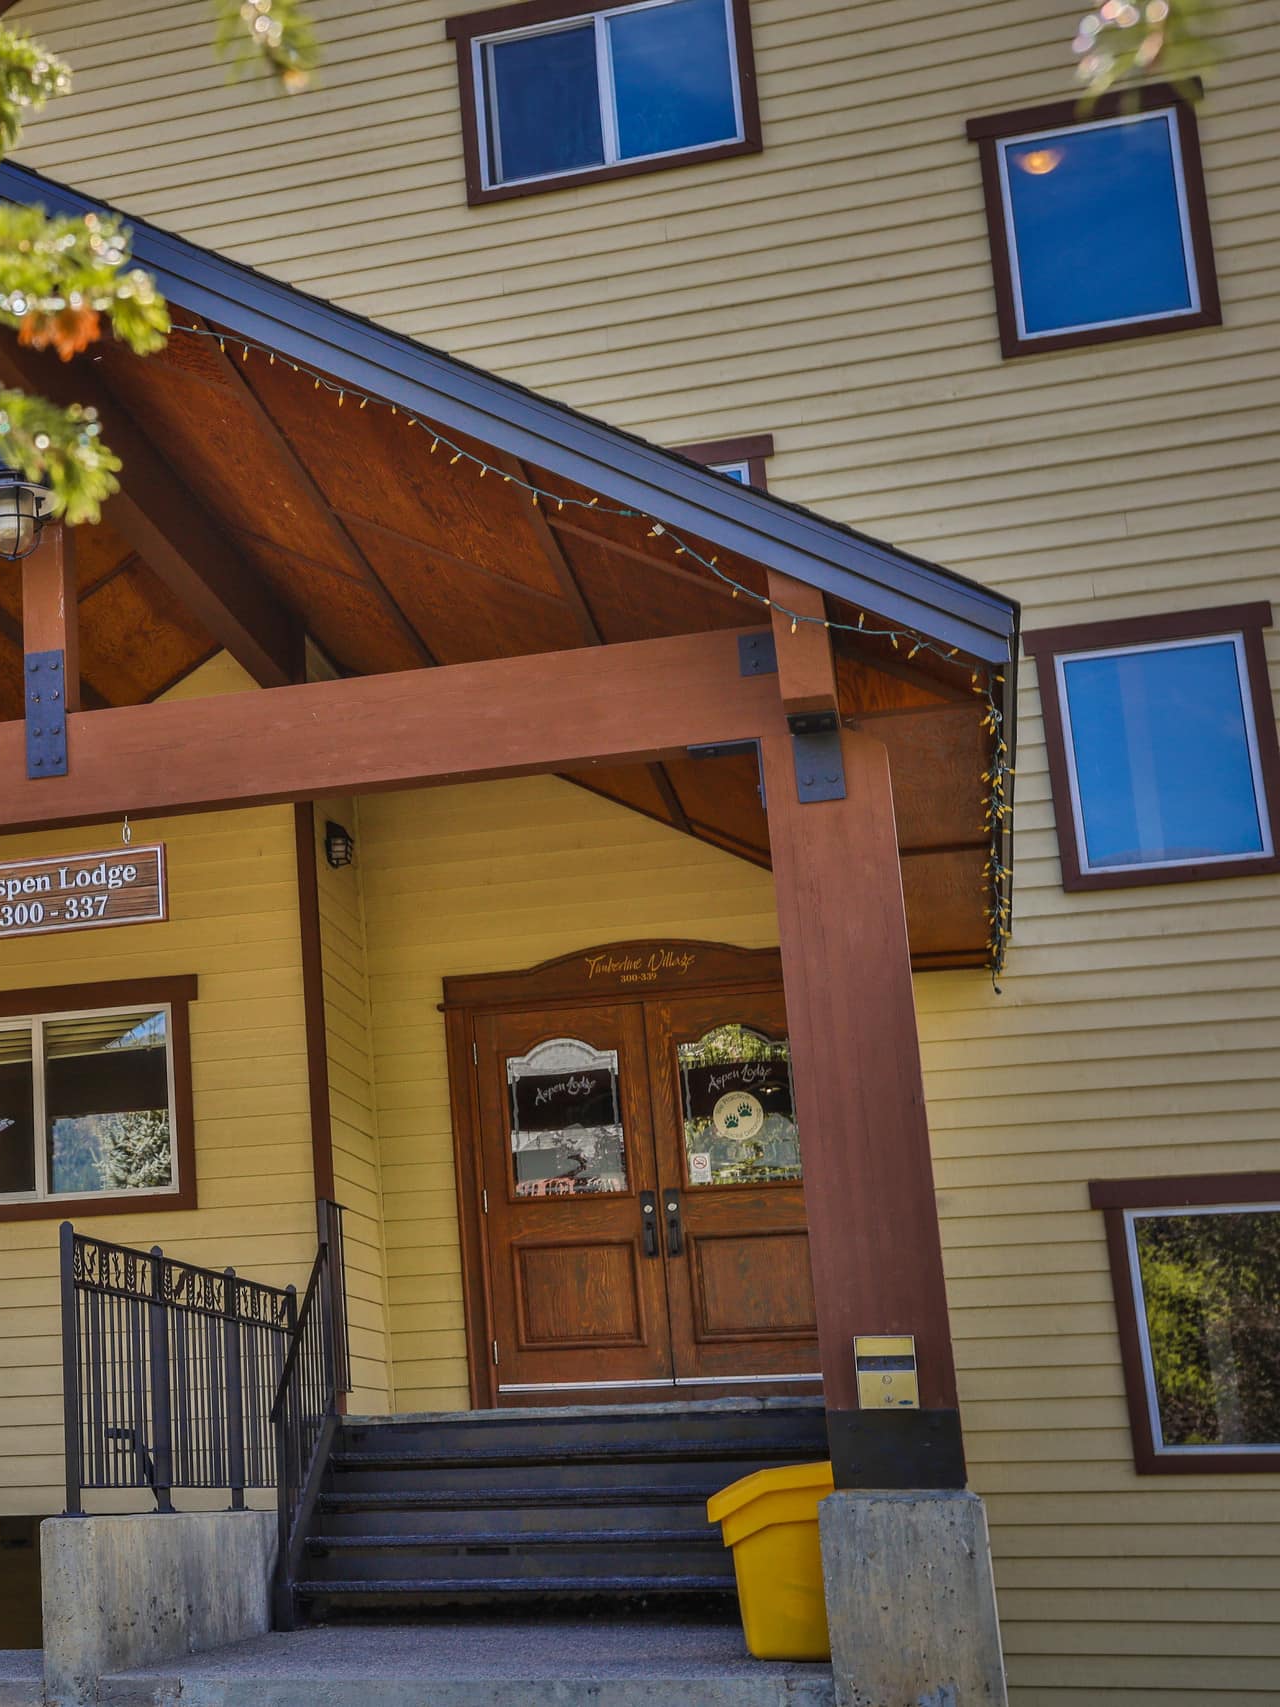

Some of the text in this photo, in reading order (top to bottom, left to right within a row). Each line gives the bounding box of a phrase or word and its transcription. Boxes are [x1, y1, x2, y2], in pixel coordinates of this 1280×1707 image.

[58, 862, 137, 889] Lodge
[0, 902, 44, 928] 300
[65, 895, 109, 920] 337
[585, 949, 696, 979] Timberline Village
[535, 1076, 596, 1106] Aspen Lodge
[708, 1063, 772, 1093] Aspen Lodge
